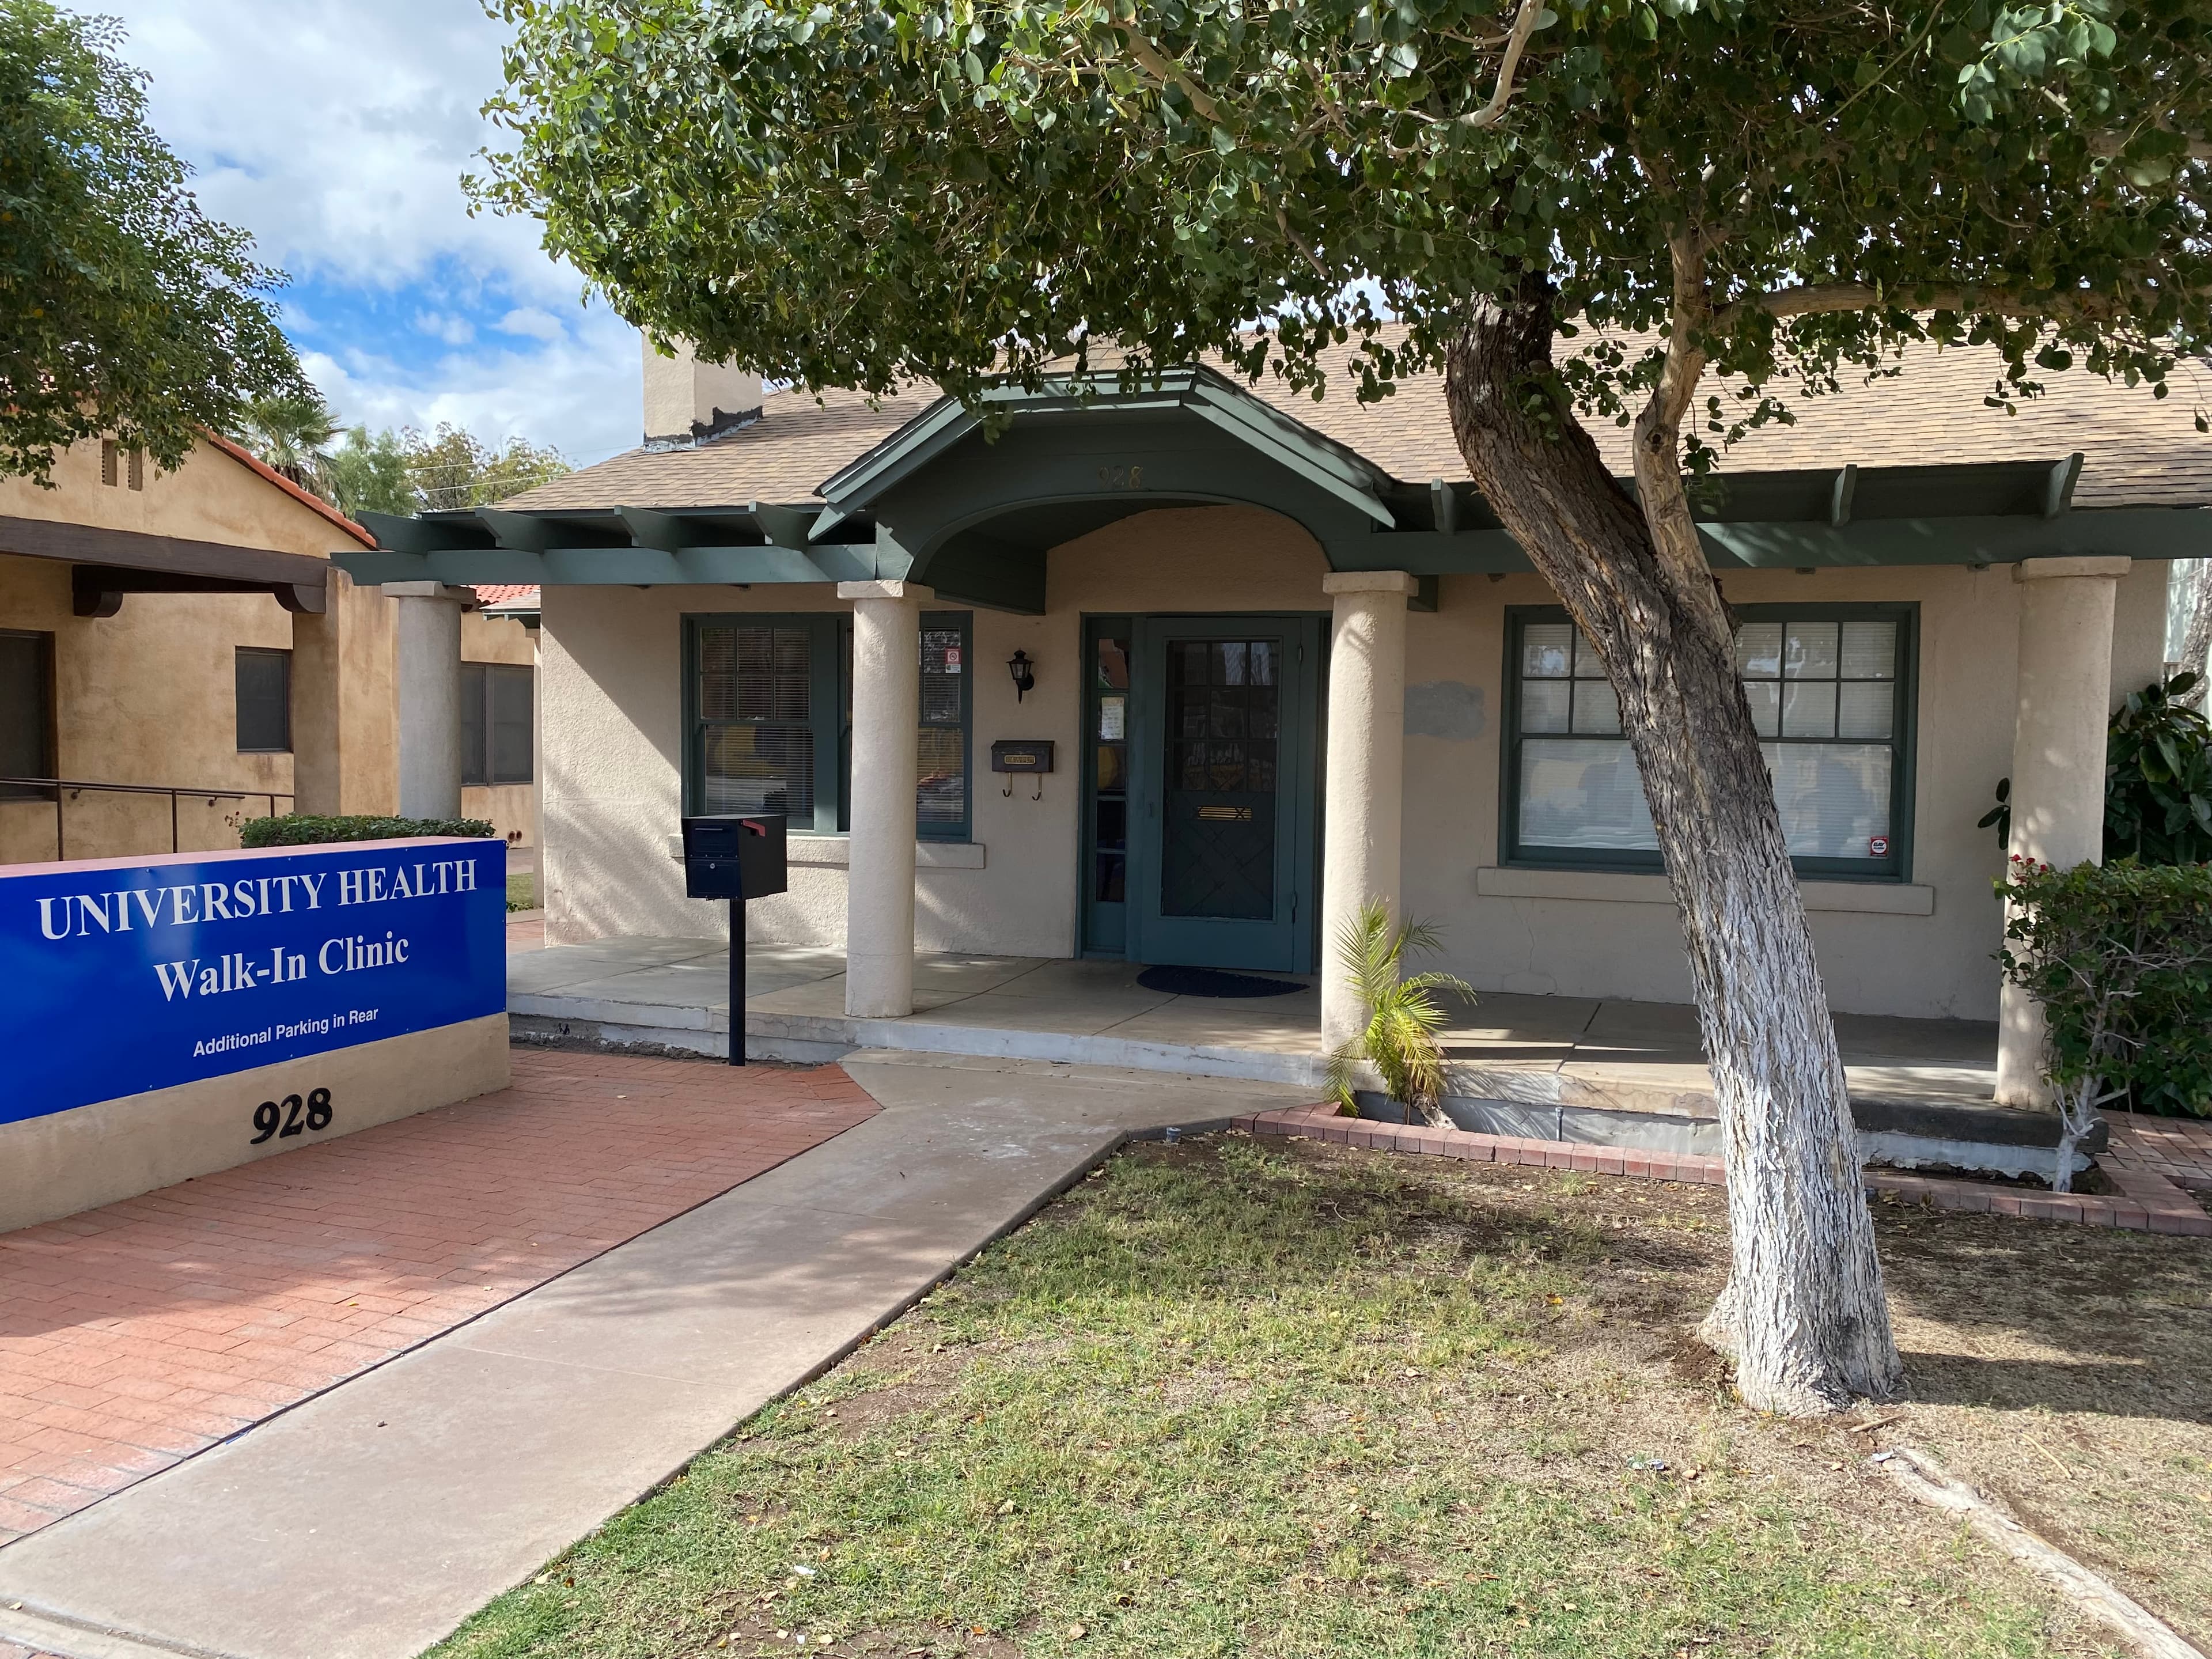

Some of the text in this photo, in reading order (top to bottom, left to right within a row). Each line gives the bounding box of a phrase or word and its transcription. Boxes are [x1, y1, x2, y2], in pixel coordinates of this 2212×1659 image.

[1097, 465, 1142, 488] 928
[36, 859, 477, 940] UNIVERSITY HEALTH
[153, 931, 408, 1002] Walk-In Clinic
[193, 1009, 378, 1057] Additional Parking in Rear
[250, 1088, 332, 1144] 928
